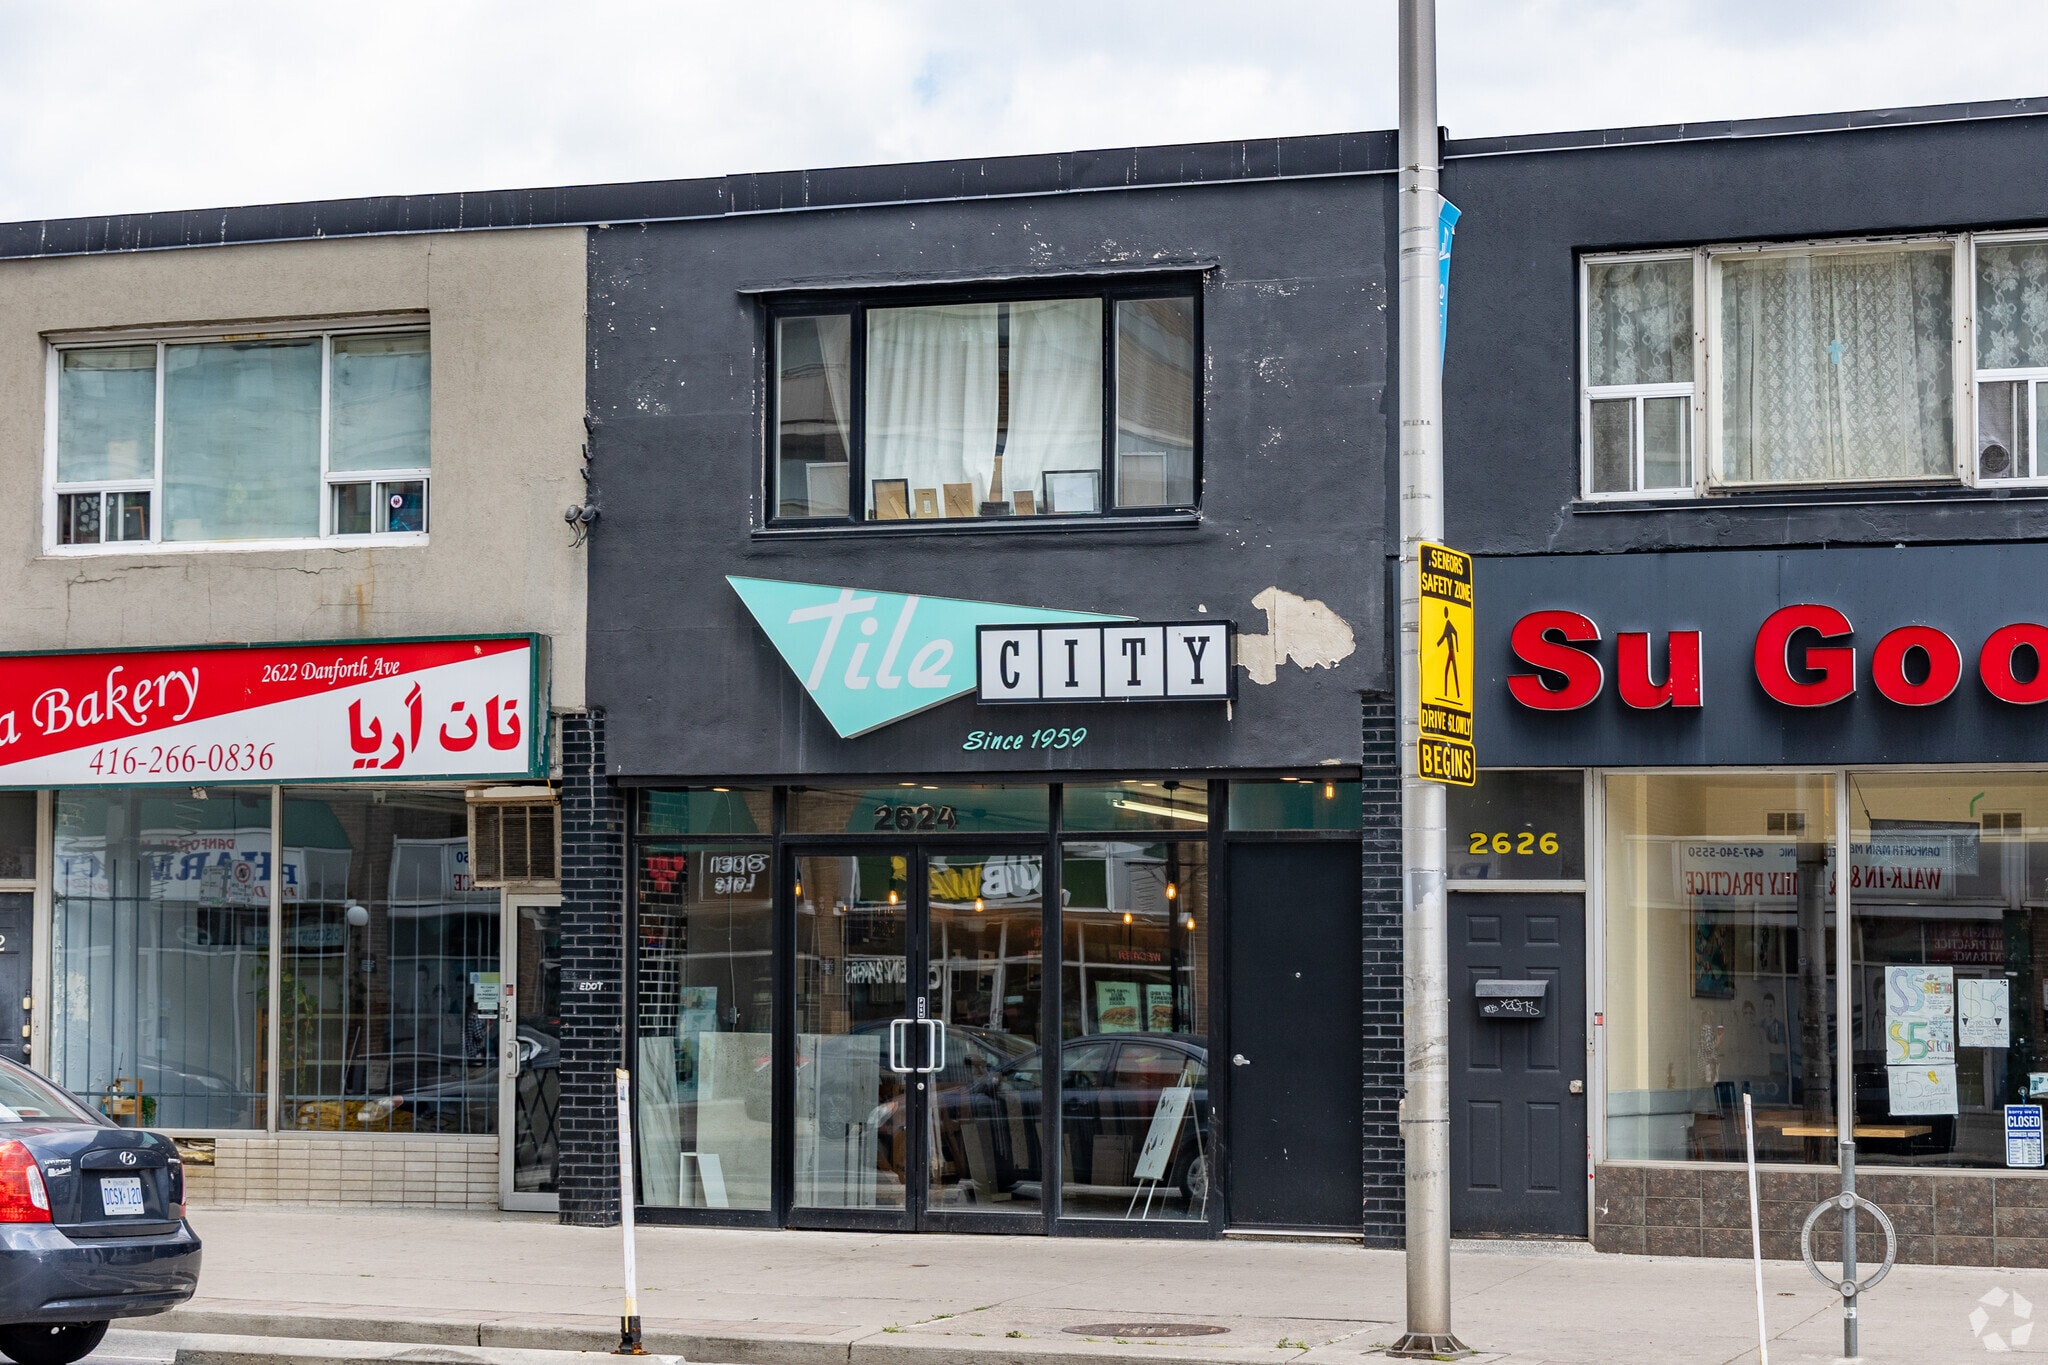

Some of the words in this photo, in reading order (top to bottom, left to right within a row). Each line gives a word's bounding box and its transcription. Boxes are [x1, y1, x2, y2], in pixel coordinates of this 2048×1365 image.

[1431, 549, 1463, 576] SENIORS
[1422, 571, 1453, 596] SAFETY
[1454, 580, 1471, 602] ZONE
[788, 588, 954, 691] Tile
[261, 663, 298, 683] 2622
[300, 656, 369, 685] Danforth
[369, 657, 400, 679] Ave
[1000, 635, 1210, 690] CITY
[1507, 609, 1704, 711] Su
[32, 665, 199, 736] Bakery
[1422, 709, 1446, 730] DRIVE
[1447, 713, 1471, 736] SLOWLY
[962, 730, 1024, 751] Since
[1031, 727, 1087, 749] 1959
[89, 742, 274, 776] 416-266-0836
[1422, 743, 1472, 779] BEGINS
[873, 804, 957, 831] 2624
[1468, 832, 1559, 855] 2626
[2008, 1115, 2040, 1128] CLOSED
